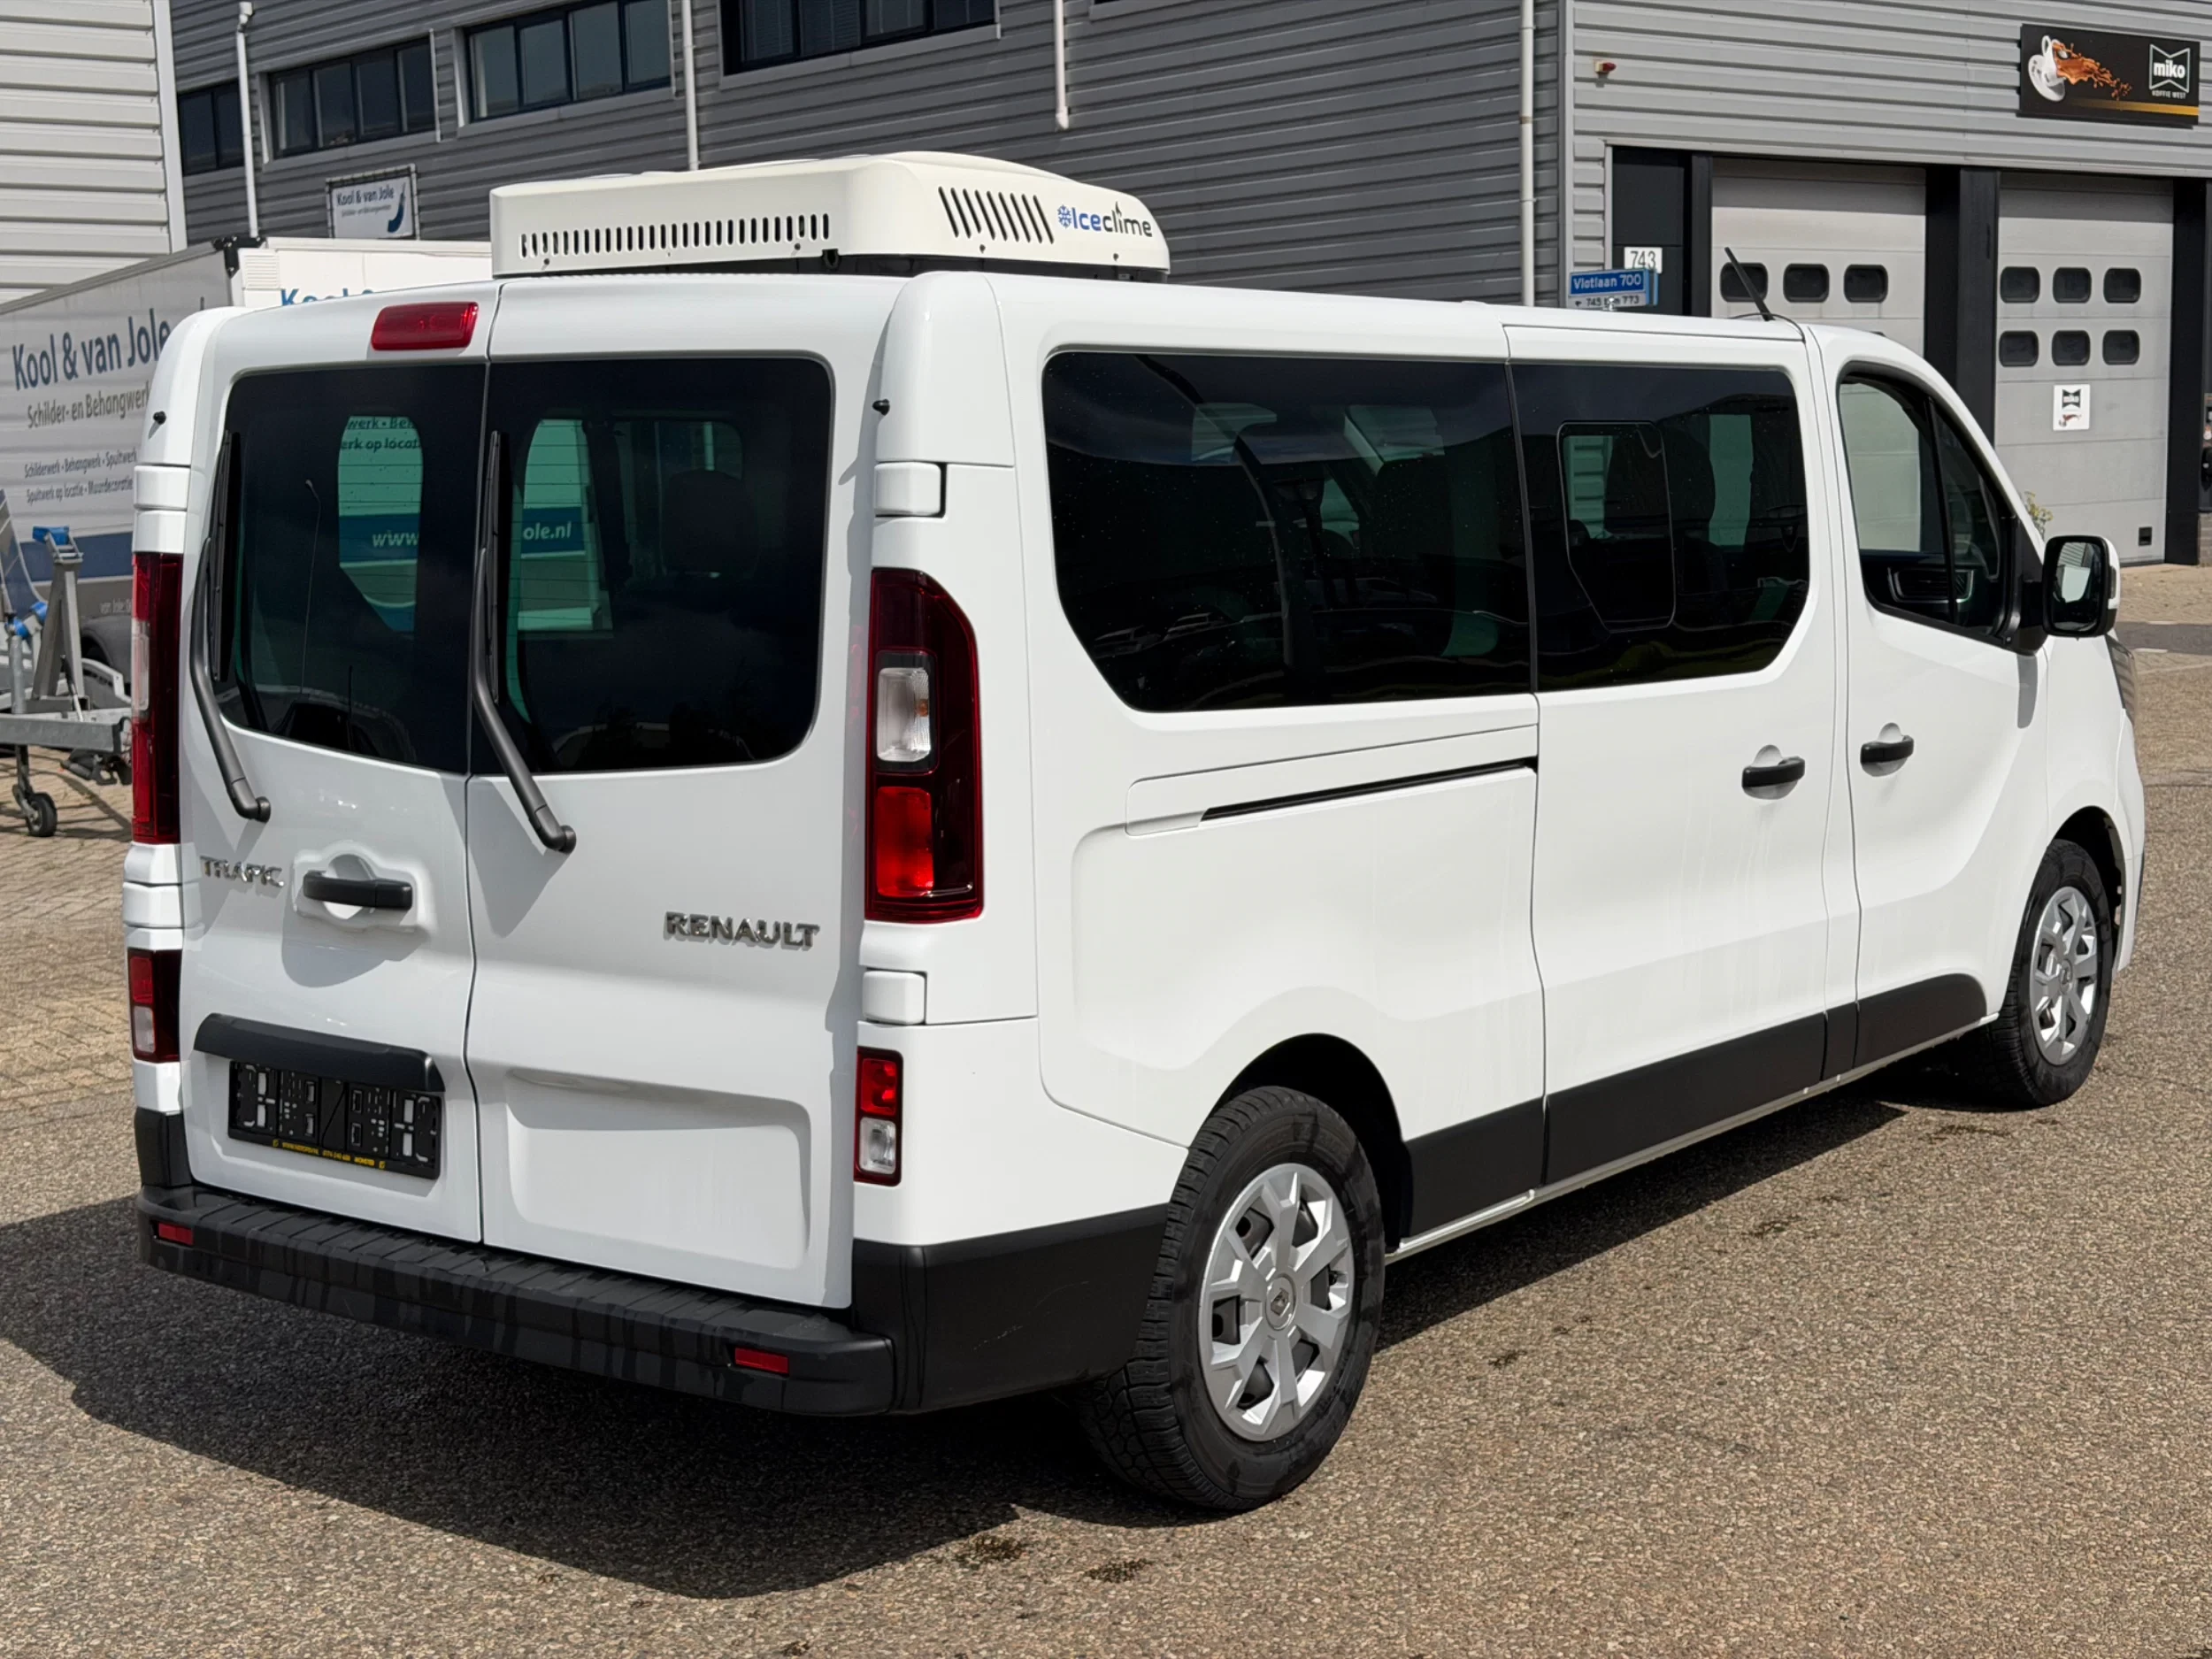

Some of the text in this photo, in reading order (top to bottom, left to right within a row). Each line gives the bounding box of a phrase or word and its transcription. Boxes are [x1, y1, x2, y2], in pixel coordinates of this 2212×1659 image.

[2153, 58, 2185, 78] miko
[337, 189, 354, 205] Kool
[356, 189, 362, 204] &
[364, 190, 378, 202] van
[1071, 201, 1153, 237] Iceclime
[1630, 250, 1656, 269] 743
[1573, 273, 1641, 290] Vlotlaan 700
[12, 308, 172, 391] Kool & van Jole
[27, 399, 69, 428] Schilder-
[72, 401, 84, 421] en
[366, 440, 382, 453] op
[199, 855, 285, 888] TRAFIC
[665, 911, 821, 948] RENAULT
